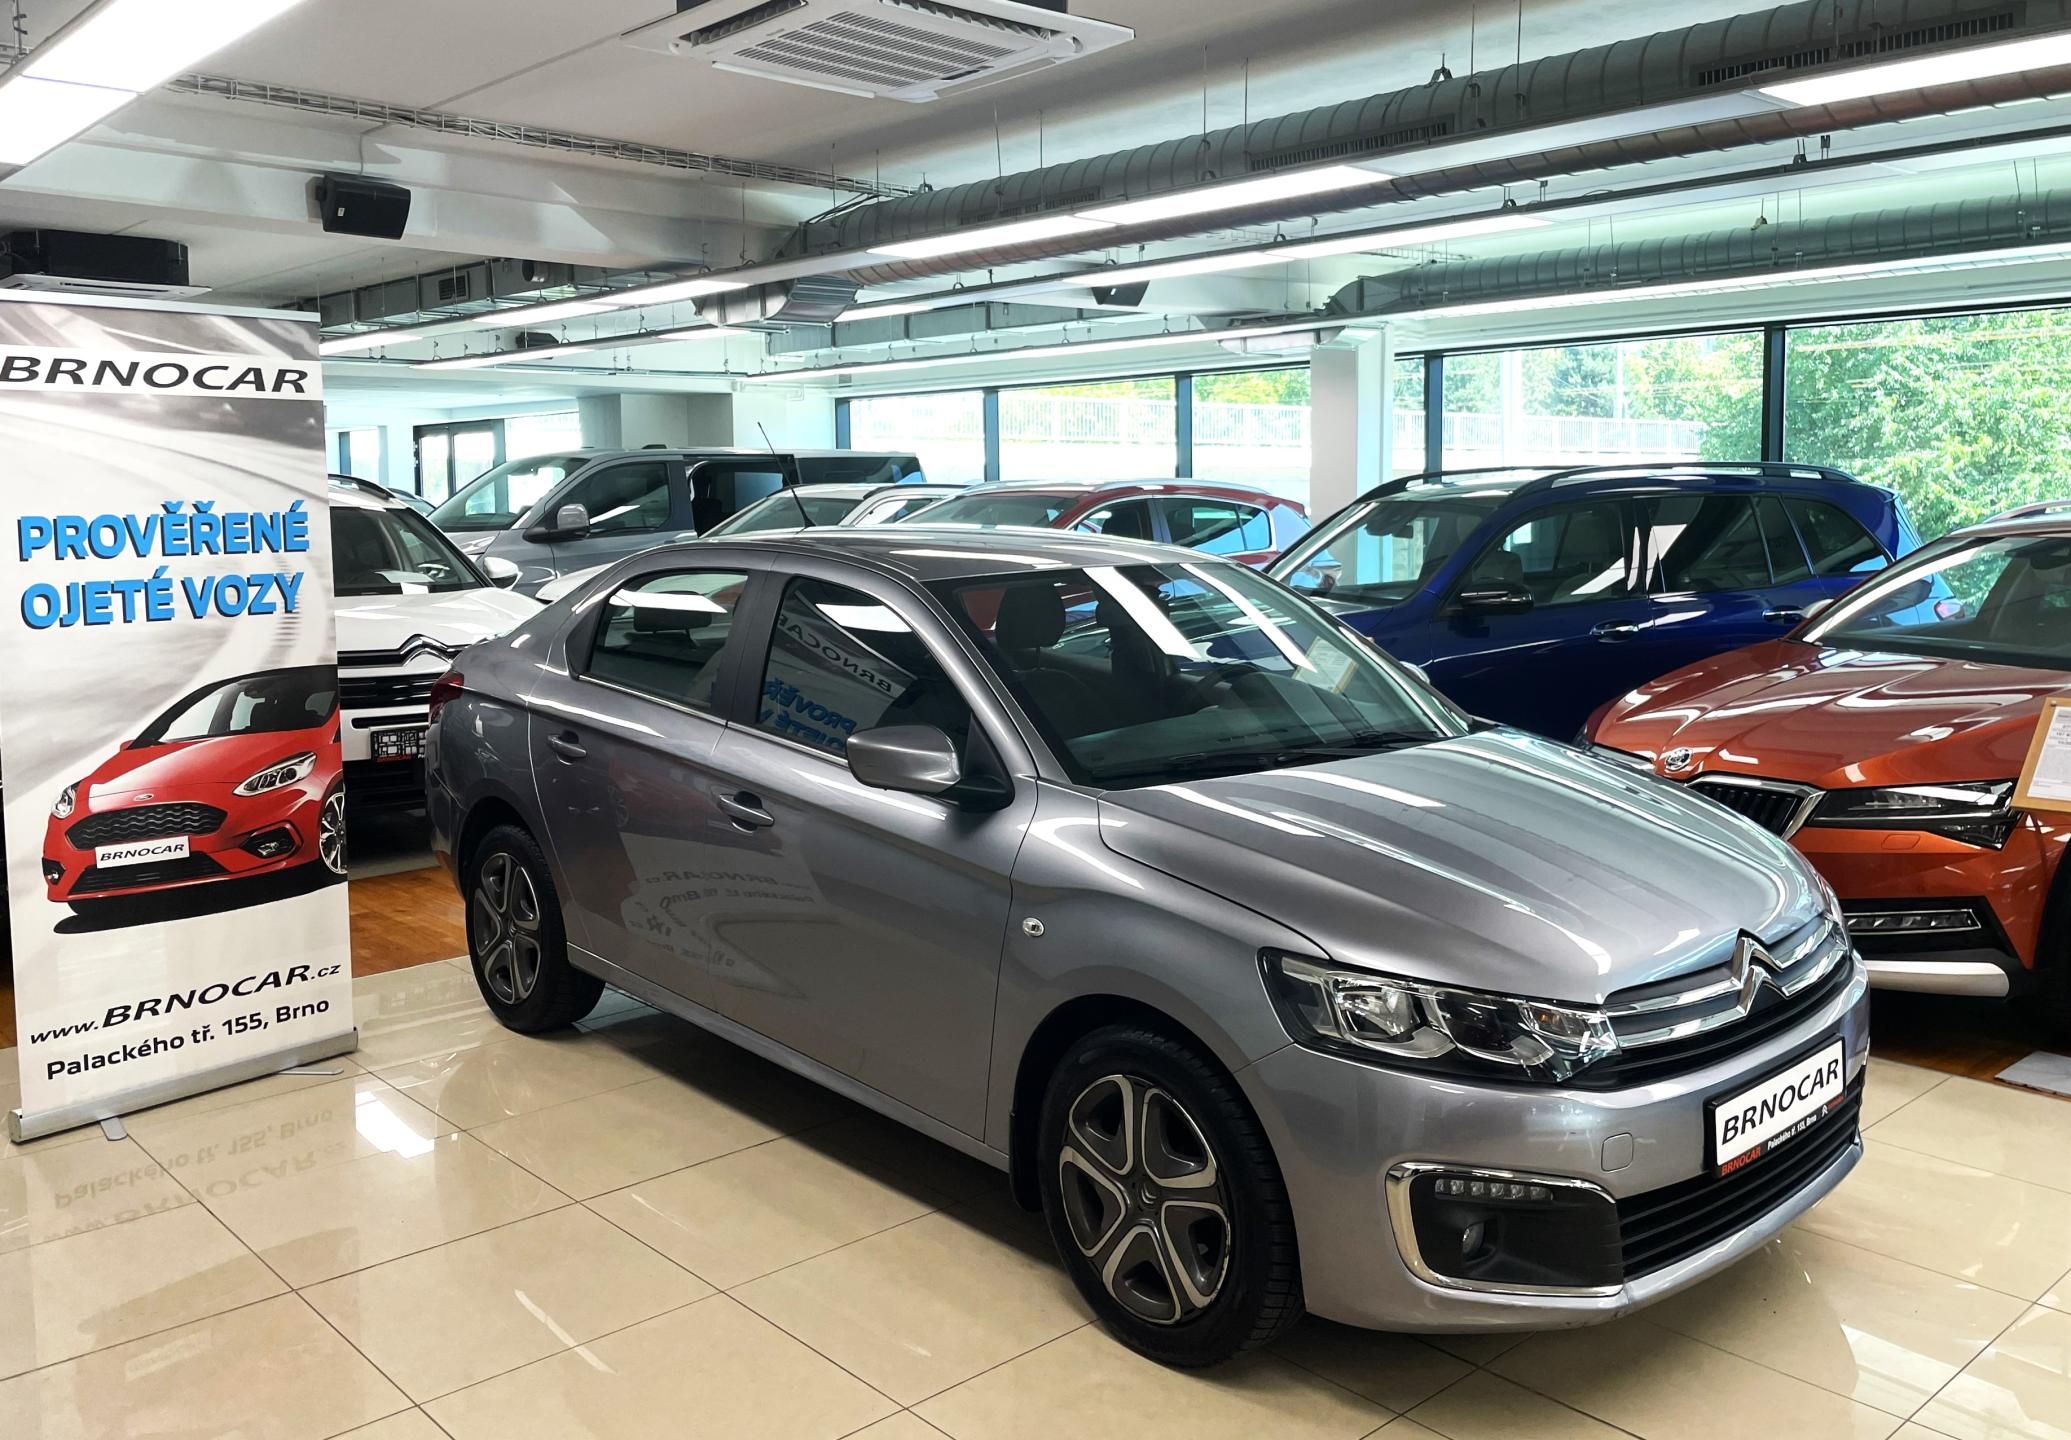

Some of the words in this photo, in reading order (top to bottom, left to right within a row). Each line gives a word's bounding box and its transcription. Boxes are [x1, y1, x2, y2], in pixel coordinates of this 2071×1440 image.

[0, 356, 308, 393] BRNOCAR
[17, 500, 310, 562] PROVĚŘENÉ
[20, 565, 175, 629] OJETÉ
[181, 572, 304, 619] VOZY
[100, 844, 184, 861] BRNOCAR
[30, 965, 341, 1044] www.BRNOCAR.cz
[47, 1035, 184, 1080] Palackého
[191, 1024, 215, 1043] tř.
[222, 1011, 269, 1036] 155,
[276, 1000, 330, 1023] Brno
[1722, 1059, 1839, 1145] BRNOCAR
[1721, 1147, 1761, 1176] BRNOCAR
